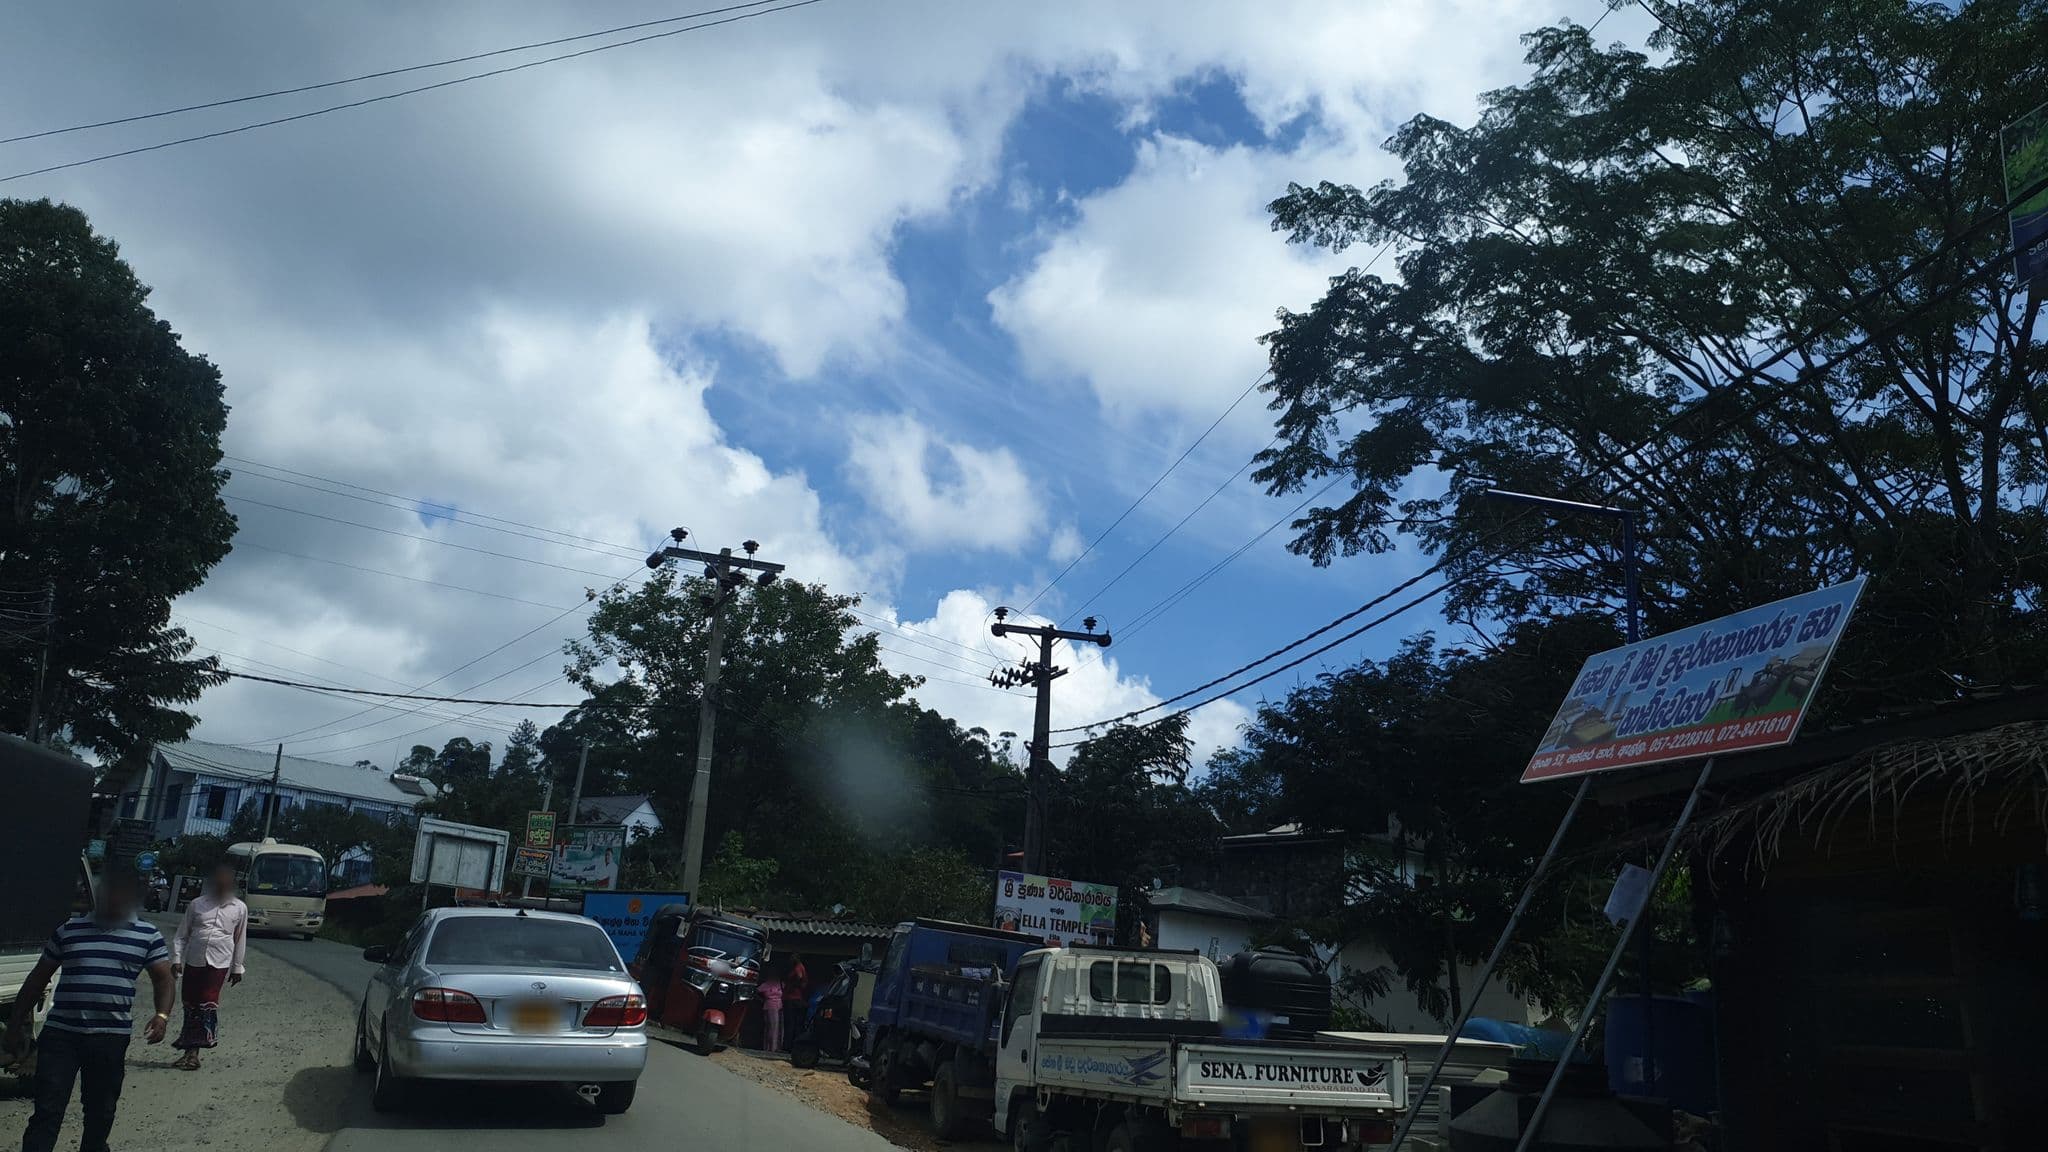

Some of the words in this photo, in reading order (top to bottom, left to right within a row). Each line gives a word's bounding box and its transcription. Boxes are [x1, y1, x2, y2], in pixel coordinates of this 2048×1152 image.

[1022, 914, 1046, 930] ELLA
[1050, 918, 1090, 936] TEMPLE
[1255, 1064, 1355, 1085] FURNITURE
